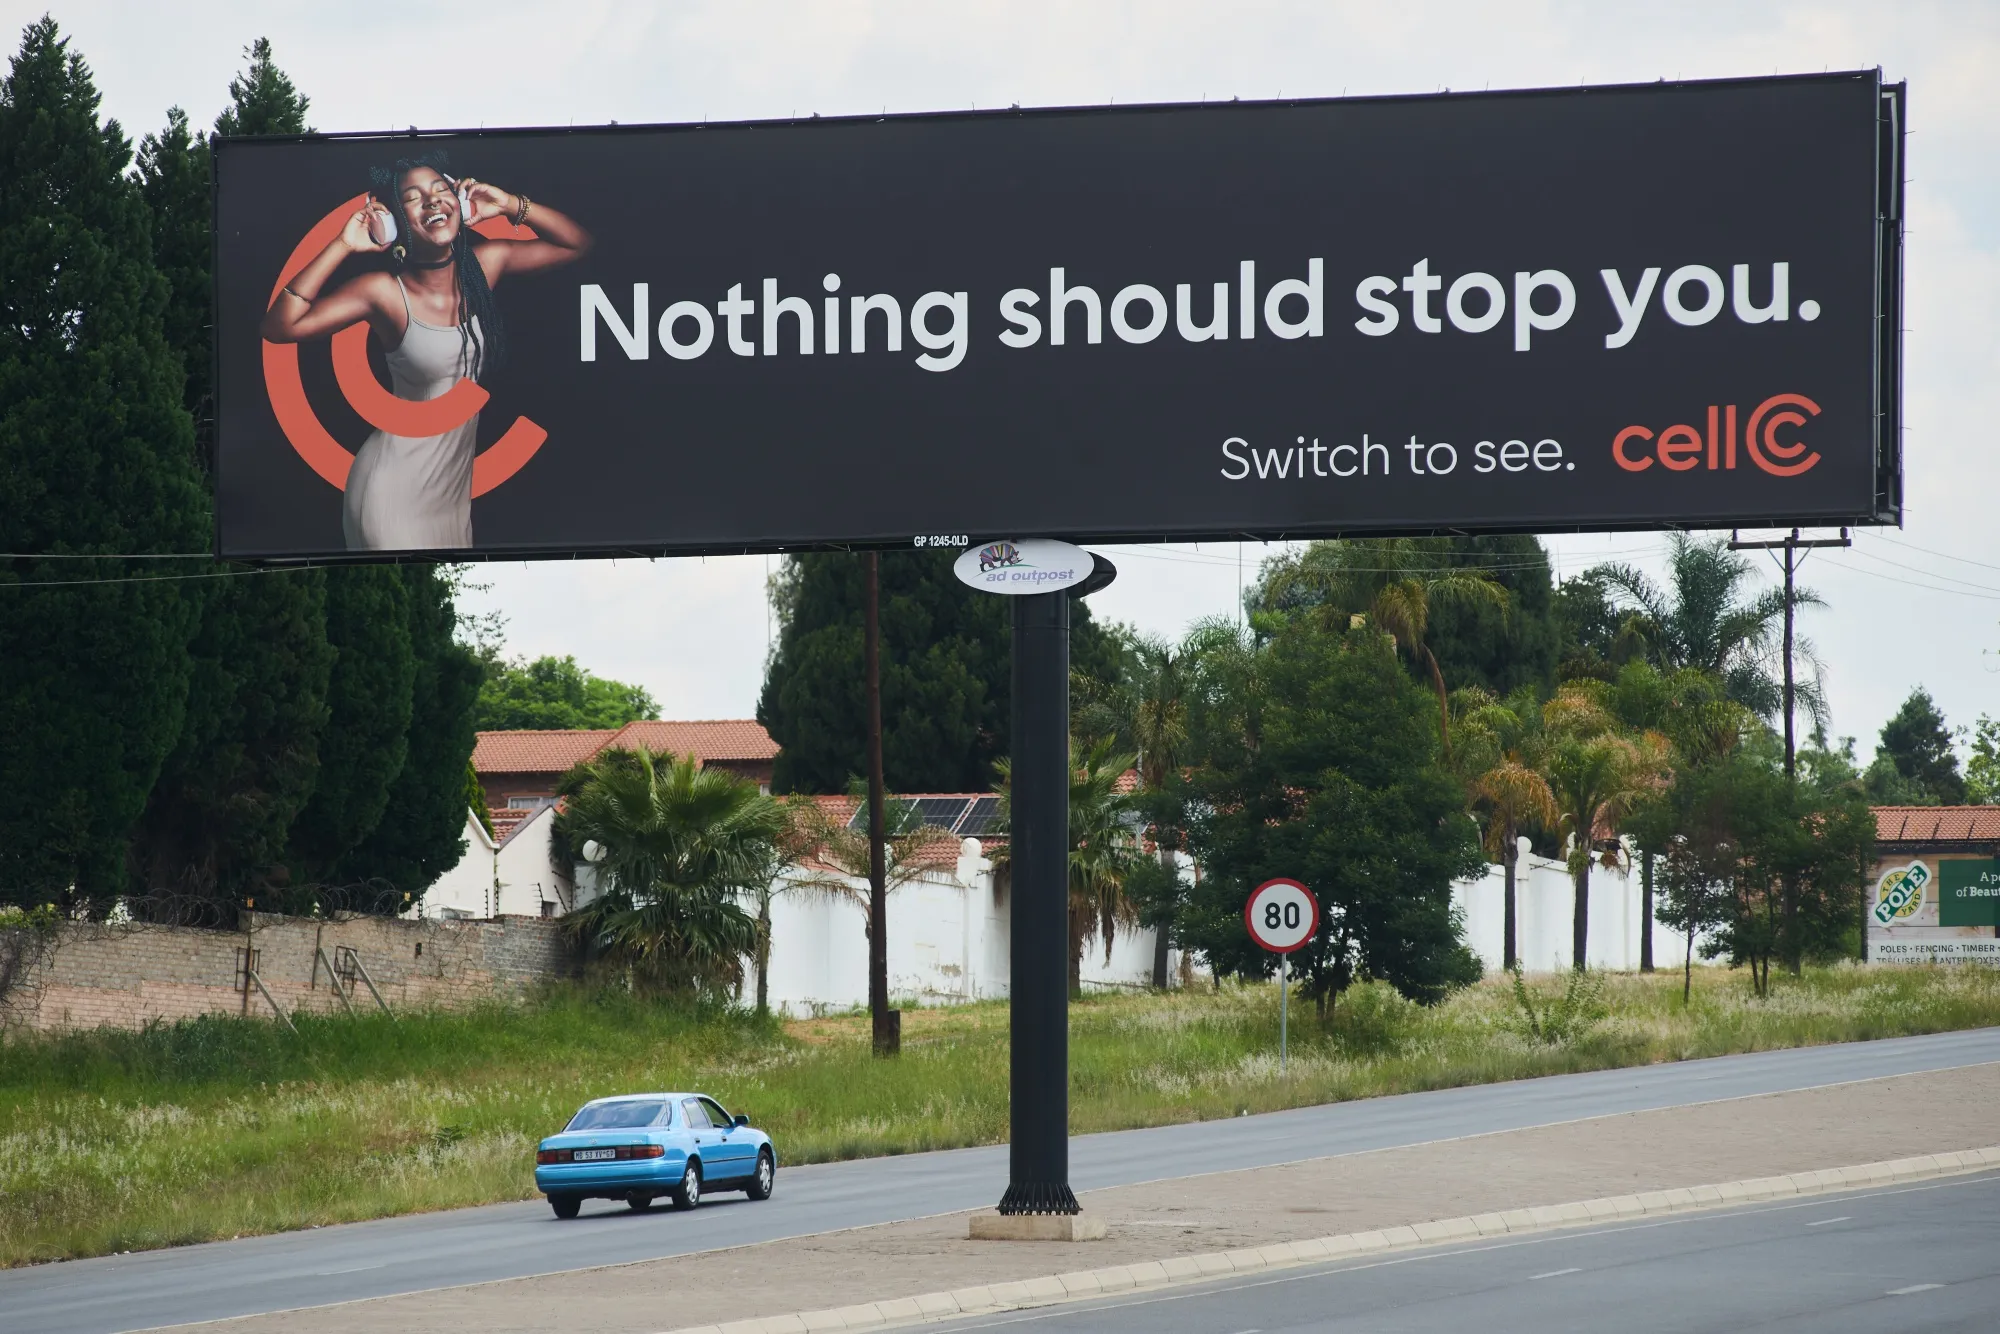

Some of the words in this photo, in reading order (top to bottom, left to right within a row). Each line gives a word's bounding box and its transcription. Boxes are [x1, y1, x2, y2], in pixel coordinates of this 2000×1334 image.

[580, 272, 969, 372] Nothing
[998, 257, 1324, 349] should
[1354, 257, 1577, 352] stop
[1600, 261, 1821, 349] you.
[1220, 433, 1390, 480] Switch
[1404, 434, 1458, 475] to
[1473, 438, 1576, 473] see.
[914, 536, 927, 547] GP
[985, 570, 1007, 582] ad
[1011, 569, 1074, 585] outpost
[1882, 873, 1900, 893] THE
[1980, 871, 1989, 882] A
[1876, 867, 1926, 921] POLE
[1956, 886, 1968, 898] of
[1901, 893, 1921, 916] YARD
[1264, 901, 1300, 930] 80
[1880, 945, 1907, 953] POLES
[1915, 944, 1954, 953] FENCING
[1961, 944, 1995, 953] TIMBER
